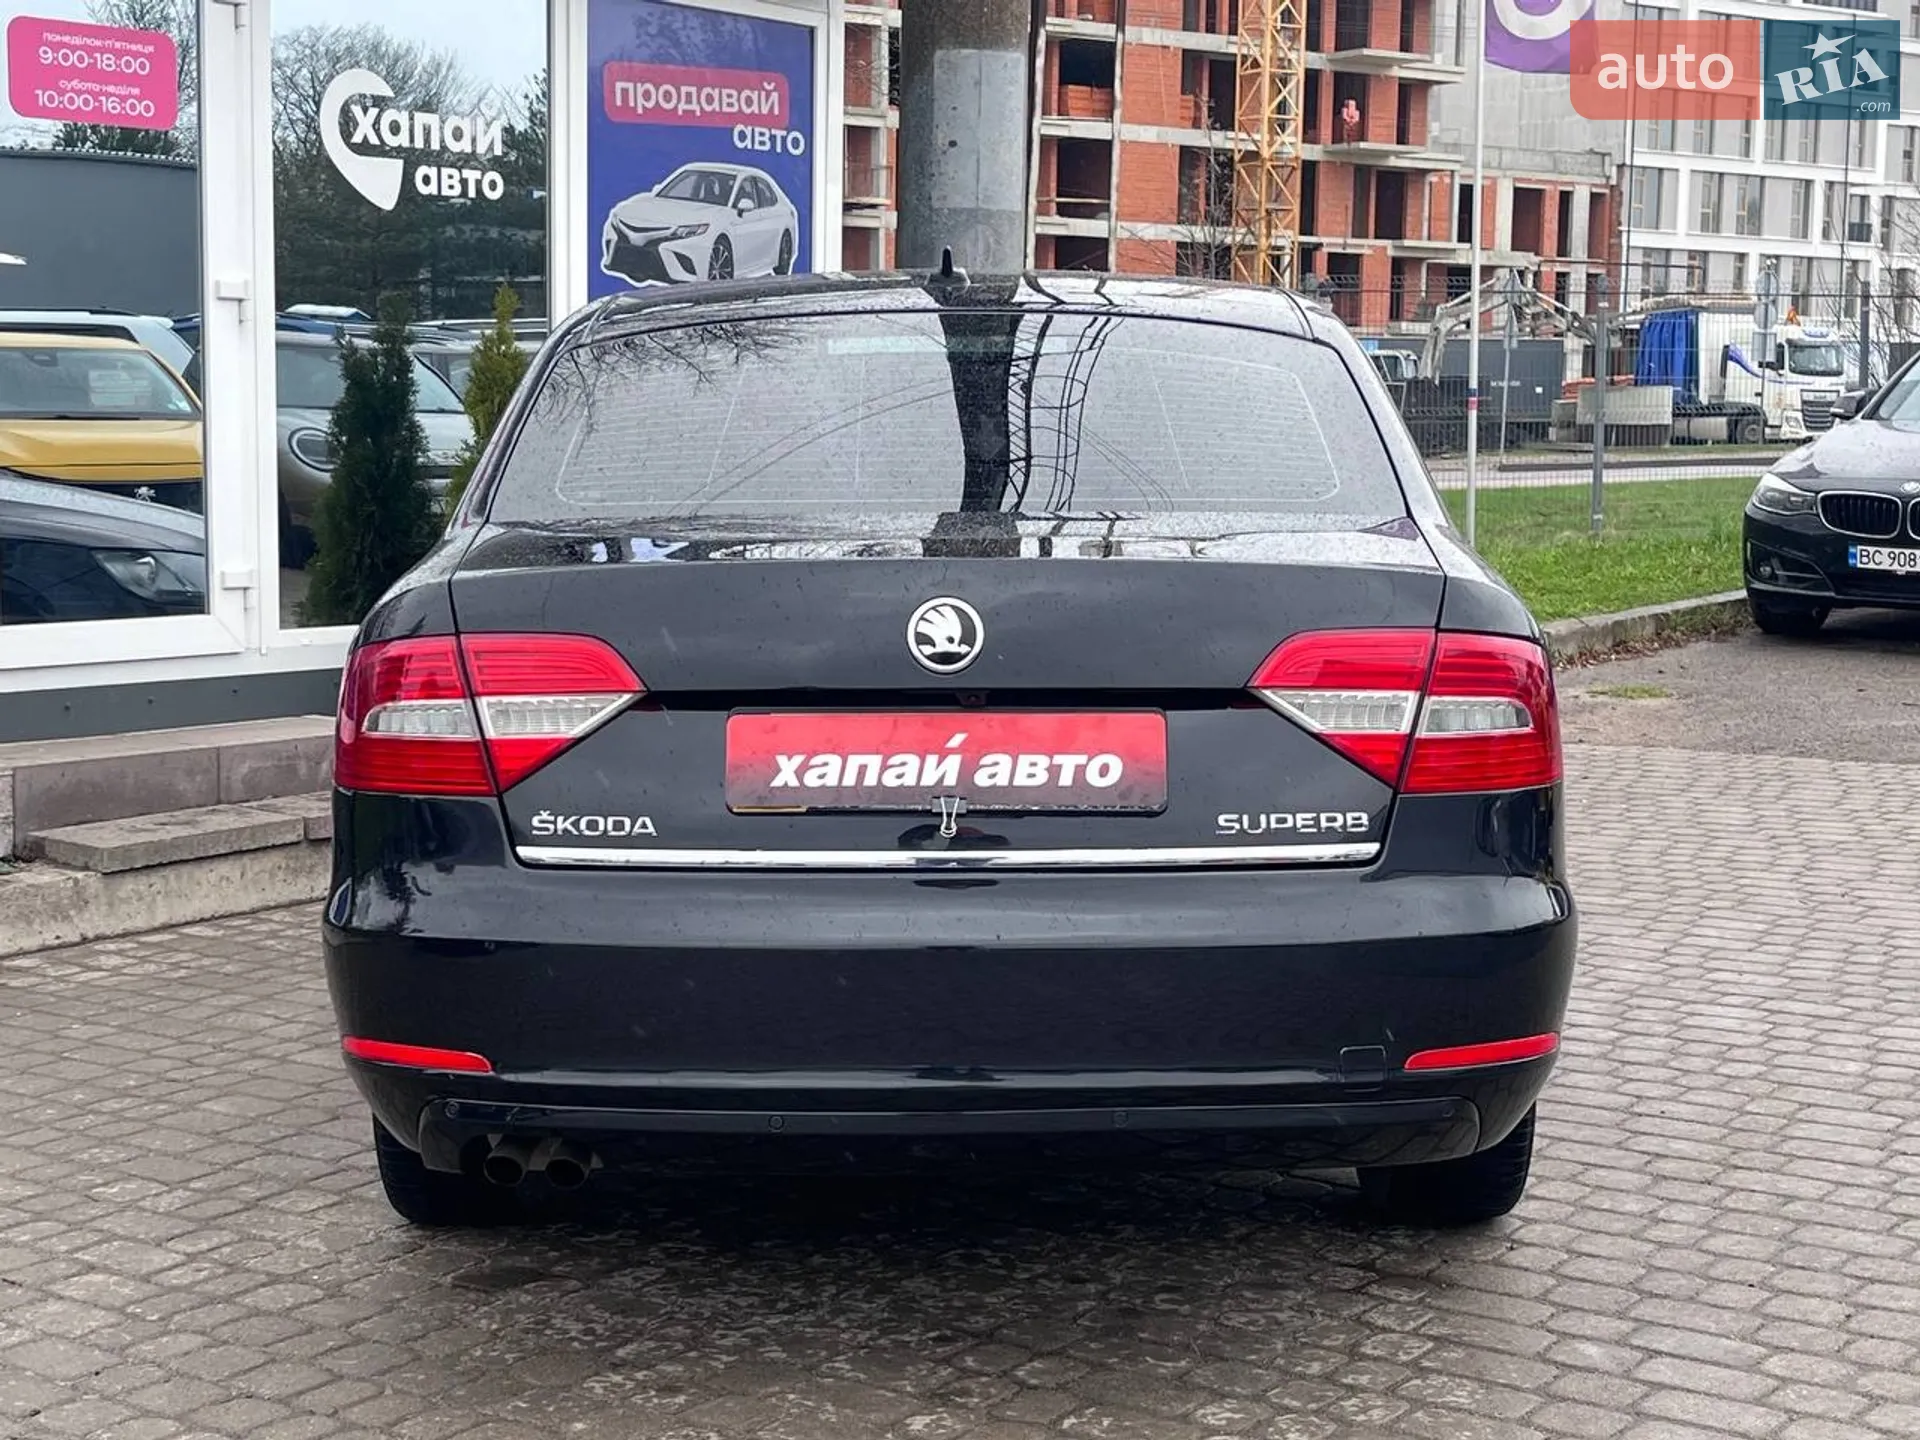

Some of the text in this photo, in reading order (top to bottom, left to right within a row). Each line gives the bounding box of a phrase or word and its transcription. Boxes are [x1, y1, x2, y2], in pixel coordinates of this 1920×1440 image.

[38, 46, 150, 75] 9:00-18:00
[34, 89, 155, 118] 10:00-16:00
[615, 81, 779, 116] продавай
[733, 123, 805, 156] авто
[414, 164, 504, 201] авто
[1859, 548, 1920, 568] BC 908
[972, 753, 1124, 788] авто
[531, 809, 658, 837] ŠKODA
[1215, 811, 1370, 835] SUPERB
